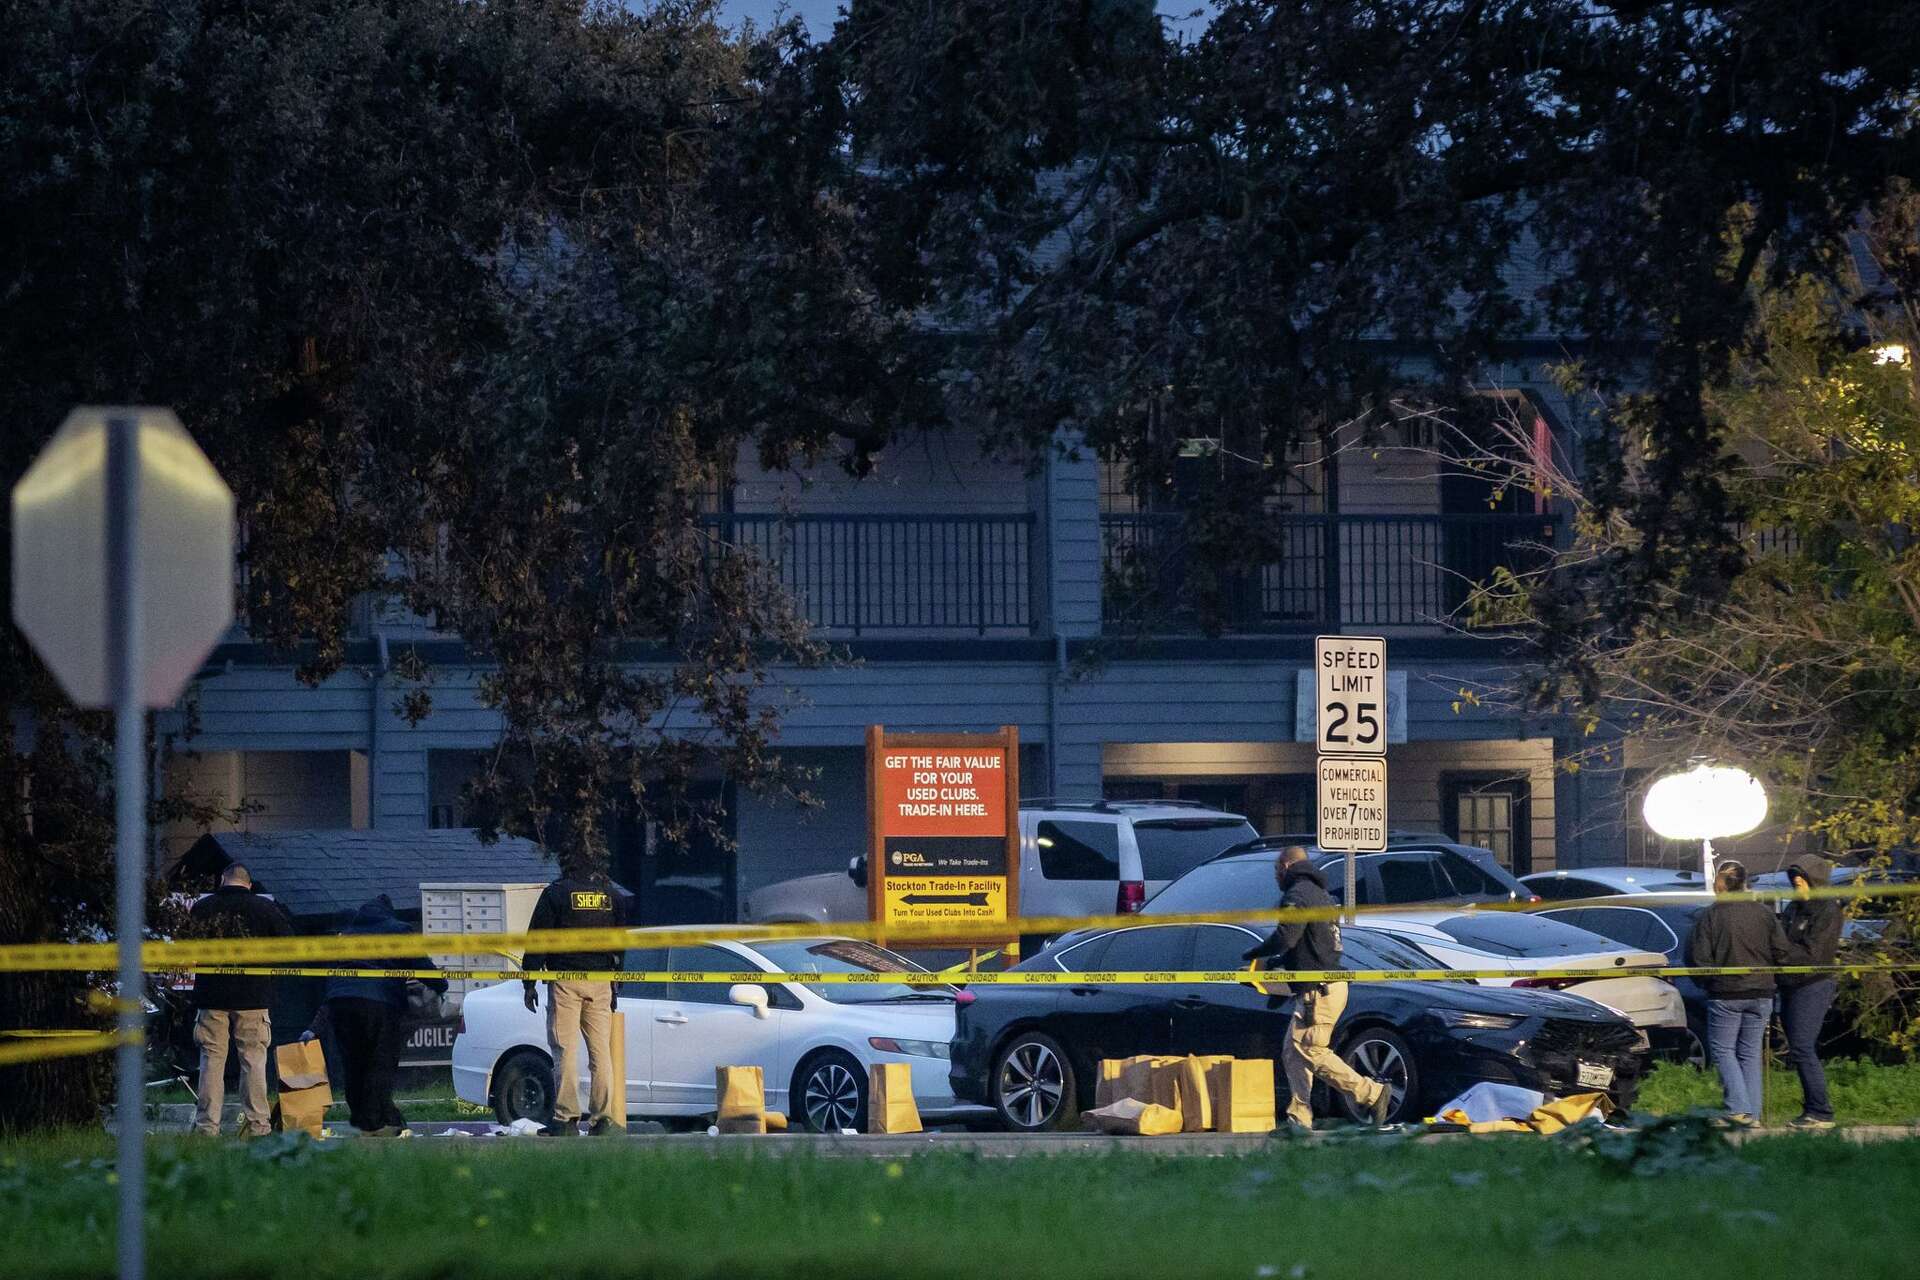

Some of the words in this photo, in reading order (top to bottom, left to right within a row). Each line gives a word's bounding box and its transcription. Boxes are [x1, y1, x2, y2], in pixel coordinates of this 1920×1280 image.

[1323, 651, 1379, 669] SPEED
[1331, 675, 1373, 692] LIMIT
[1326, 702, 1378, 744] 25
[885, 756, 908, 769] GET
[910, 756, 933, 769] THE
[936, 756, 961, 769] FAIR
[963, 756, 1001, 769] VALUE
[914, 772, 938, 784] FOR
[940, 772, 973, 784] YOUR
[1322, 768, 1383, 782] COMMERCIAL
[907, 788, 938, 800] USED
[940, 788, 979, 800] CLUBS.
[1330, 787, 1376, 801] VEHICLES
[898, 804, 952, 816] TRADE-IN
[955, 804, 988, 816] HERE.
[1323, 806, 1348, 820] OVER
[1348, 803, 1358, 825] 7
[1358, 807, 1383, 821] TONS
[1325, 826, 1381, 841] PROHIBITED
[903, 853, 924, 862] PGA
[886, 881, 927, 891] Stockton
[929, 881, 966, 891] Trade-In
[968, 881, 1001, 893] Facility
[893, 908, 908, 917] Turn
[909, 908, 924, 917] Your
[926, 908, 942, 917] Used
[943, 908, 962, 917] Clubs
[963, 908, 976, 917] Into
[441, 970, 473, 979] CAUTION
[556, 972, 588, 981] CAUTION
[613, 972, 645, 981] CUIDADO
[672, 973, 704, 981] CAUTION
[730, 973, 762, 981] CUIDADO
[789, 973, 821, 982] CAUTION
[848, 973, 880, 982] CUIDADO
[906, 973, 939, 982] CAUTION
[965, 973, 997, 982] CUIDADO
[1025, 973, 1057, 982] CAUTION
[1084, 973, 1117, 982] CUIDADO
[1144, 973, 1176, 982] CAUTION
[1203, 972, 1236, 981] CUIDADO
[1264, 972, 1296, 980] CAUTION
[1323, 971, 1356, 980] CUIDADO
